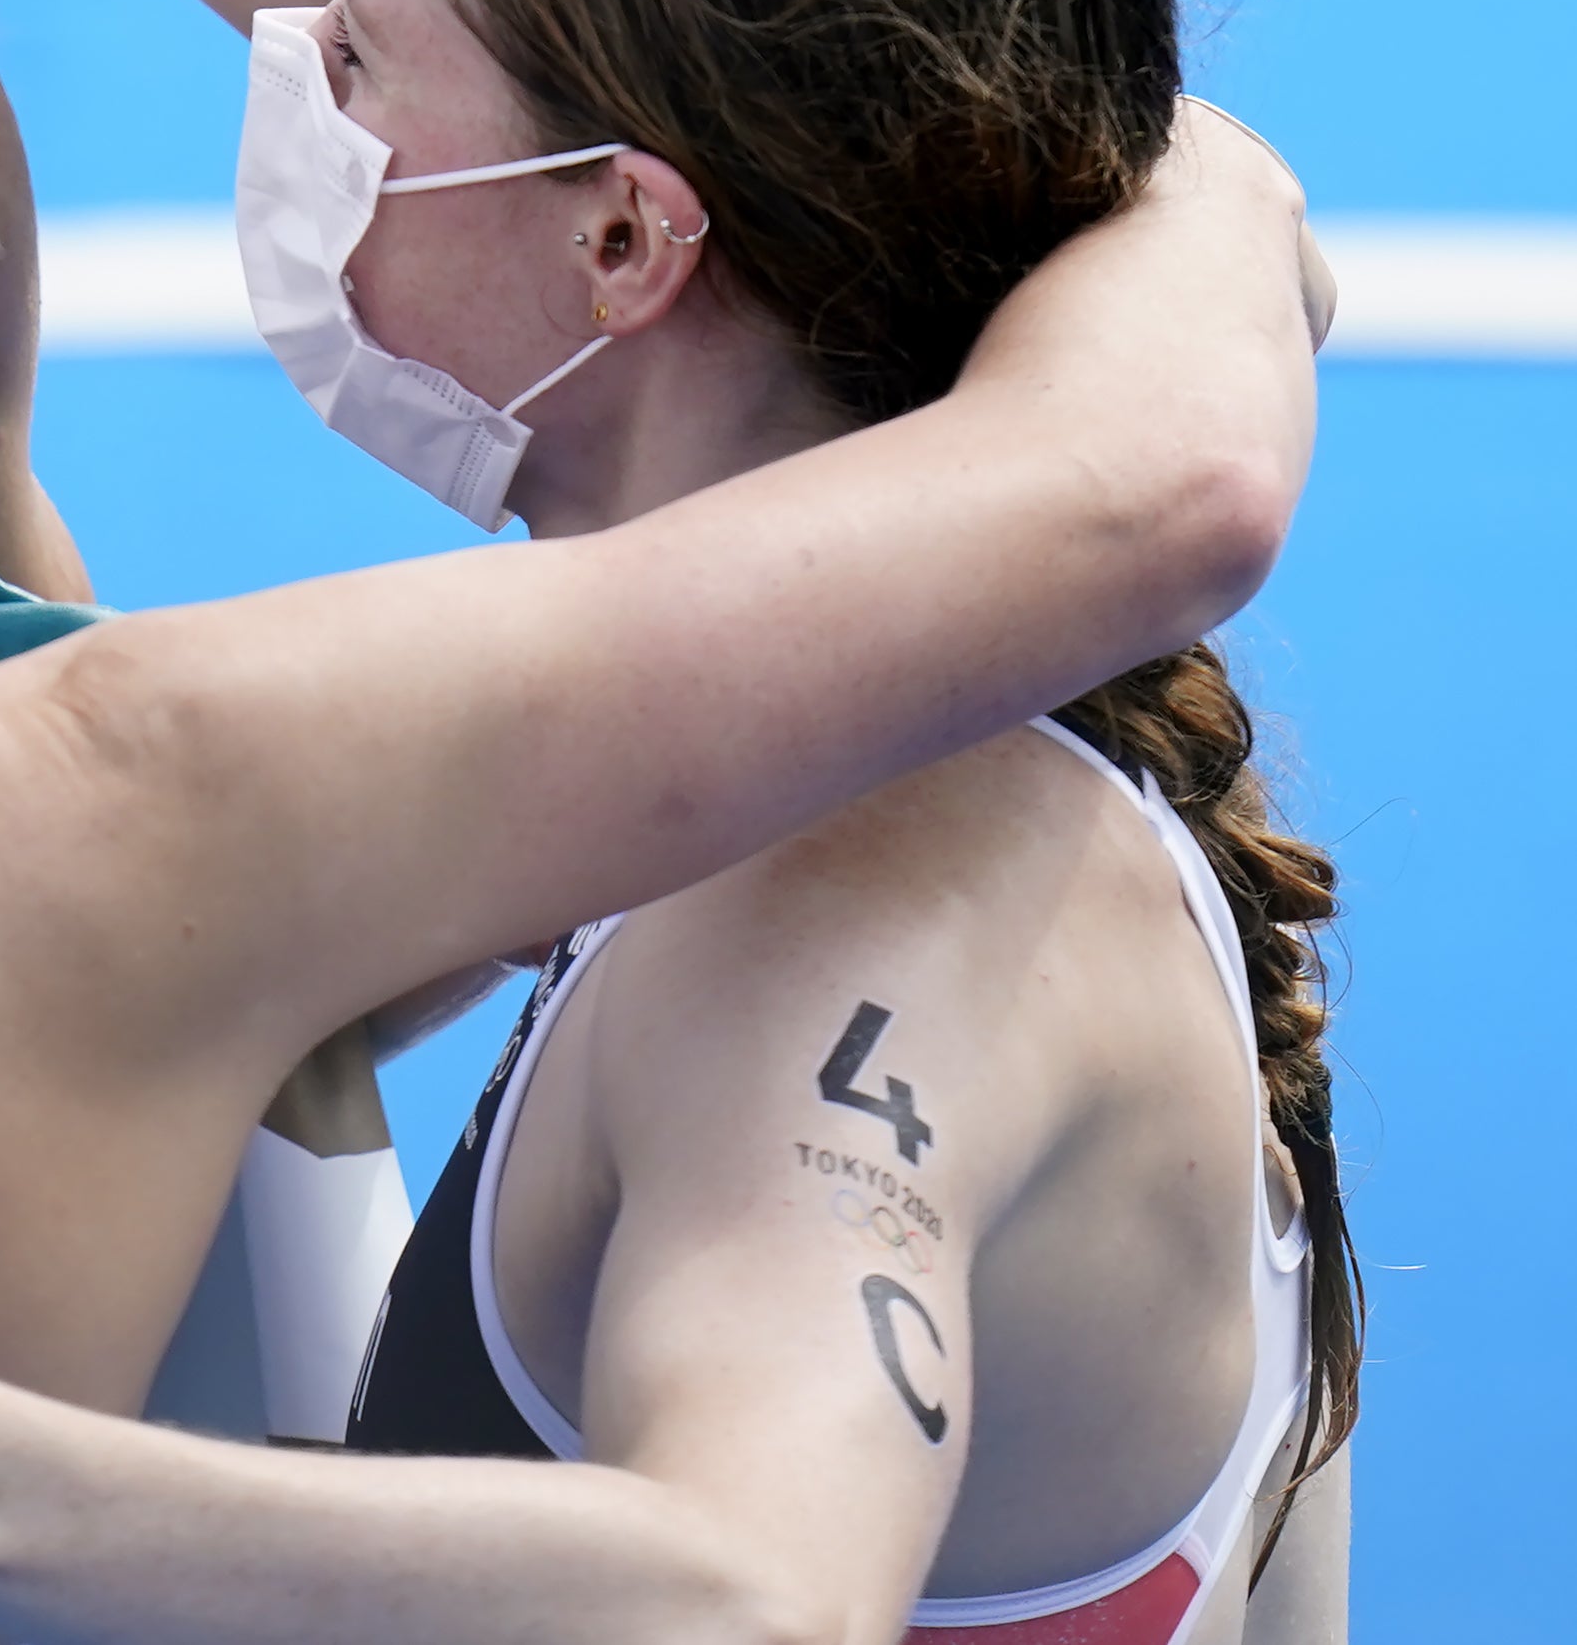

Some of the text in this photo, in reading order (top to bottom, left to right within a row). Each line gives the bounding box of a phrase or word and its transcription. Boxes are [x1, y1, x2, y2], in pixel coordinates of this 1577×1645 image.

[818, 999, 934, 1166] 4
[793, 1141, 899, 1199] TOKYO
[861, 1273, 947, 1444] C
